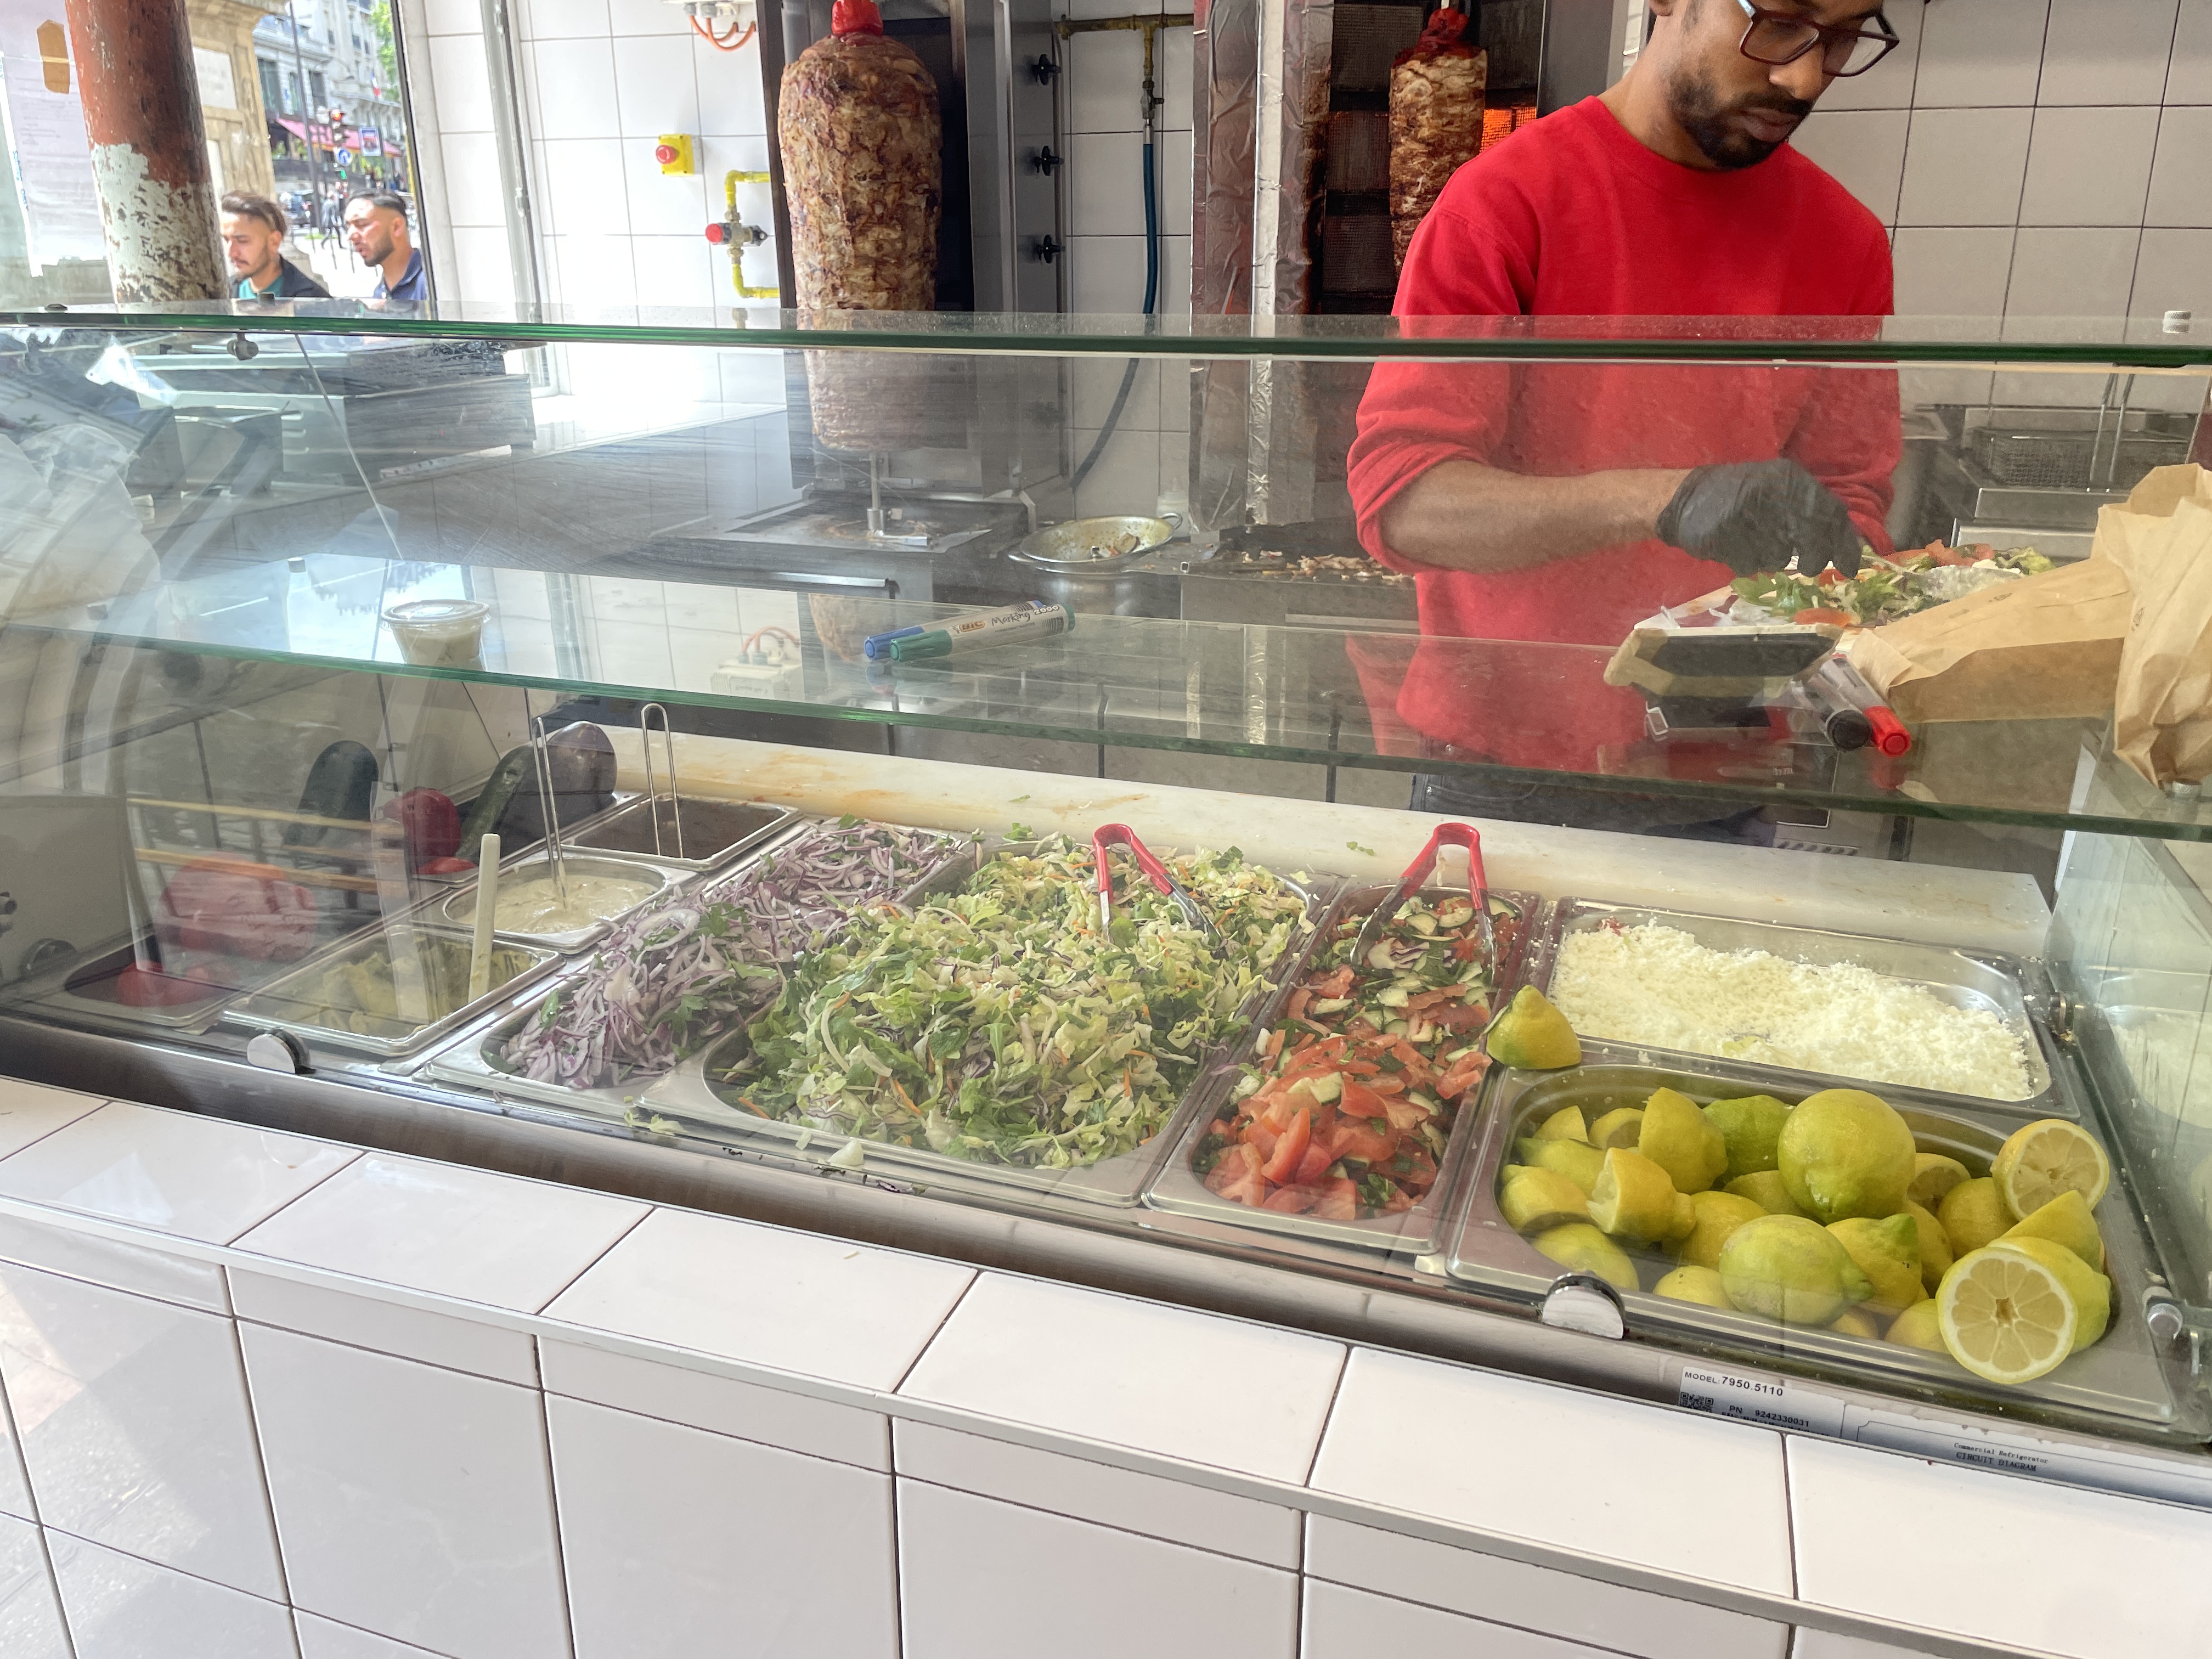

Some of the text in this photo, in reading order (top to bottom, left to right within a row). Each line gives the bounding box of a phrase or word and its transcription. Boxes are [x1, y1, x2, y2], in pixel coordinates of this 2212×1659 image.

[961, 621, 984, 631] BIC
[991, 605, 1060, 627] Marking 2000
[1722, 1376, 1784, 1396] 7950.5110
[1755, 1409, 1810, 1427] 9242330031
[1954, 1442, 2049, 1464] Commercial Refrigerator
[1956, 1452, 2036, 1472] CIRCUIT DIAGRAM
